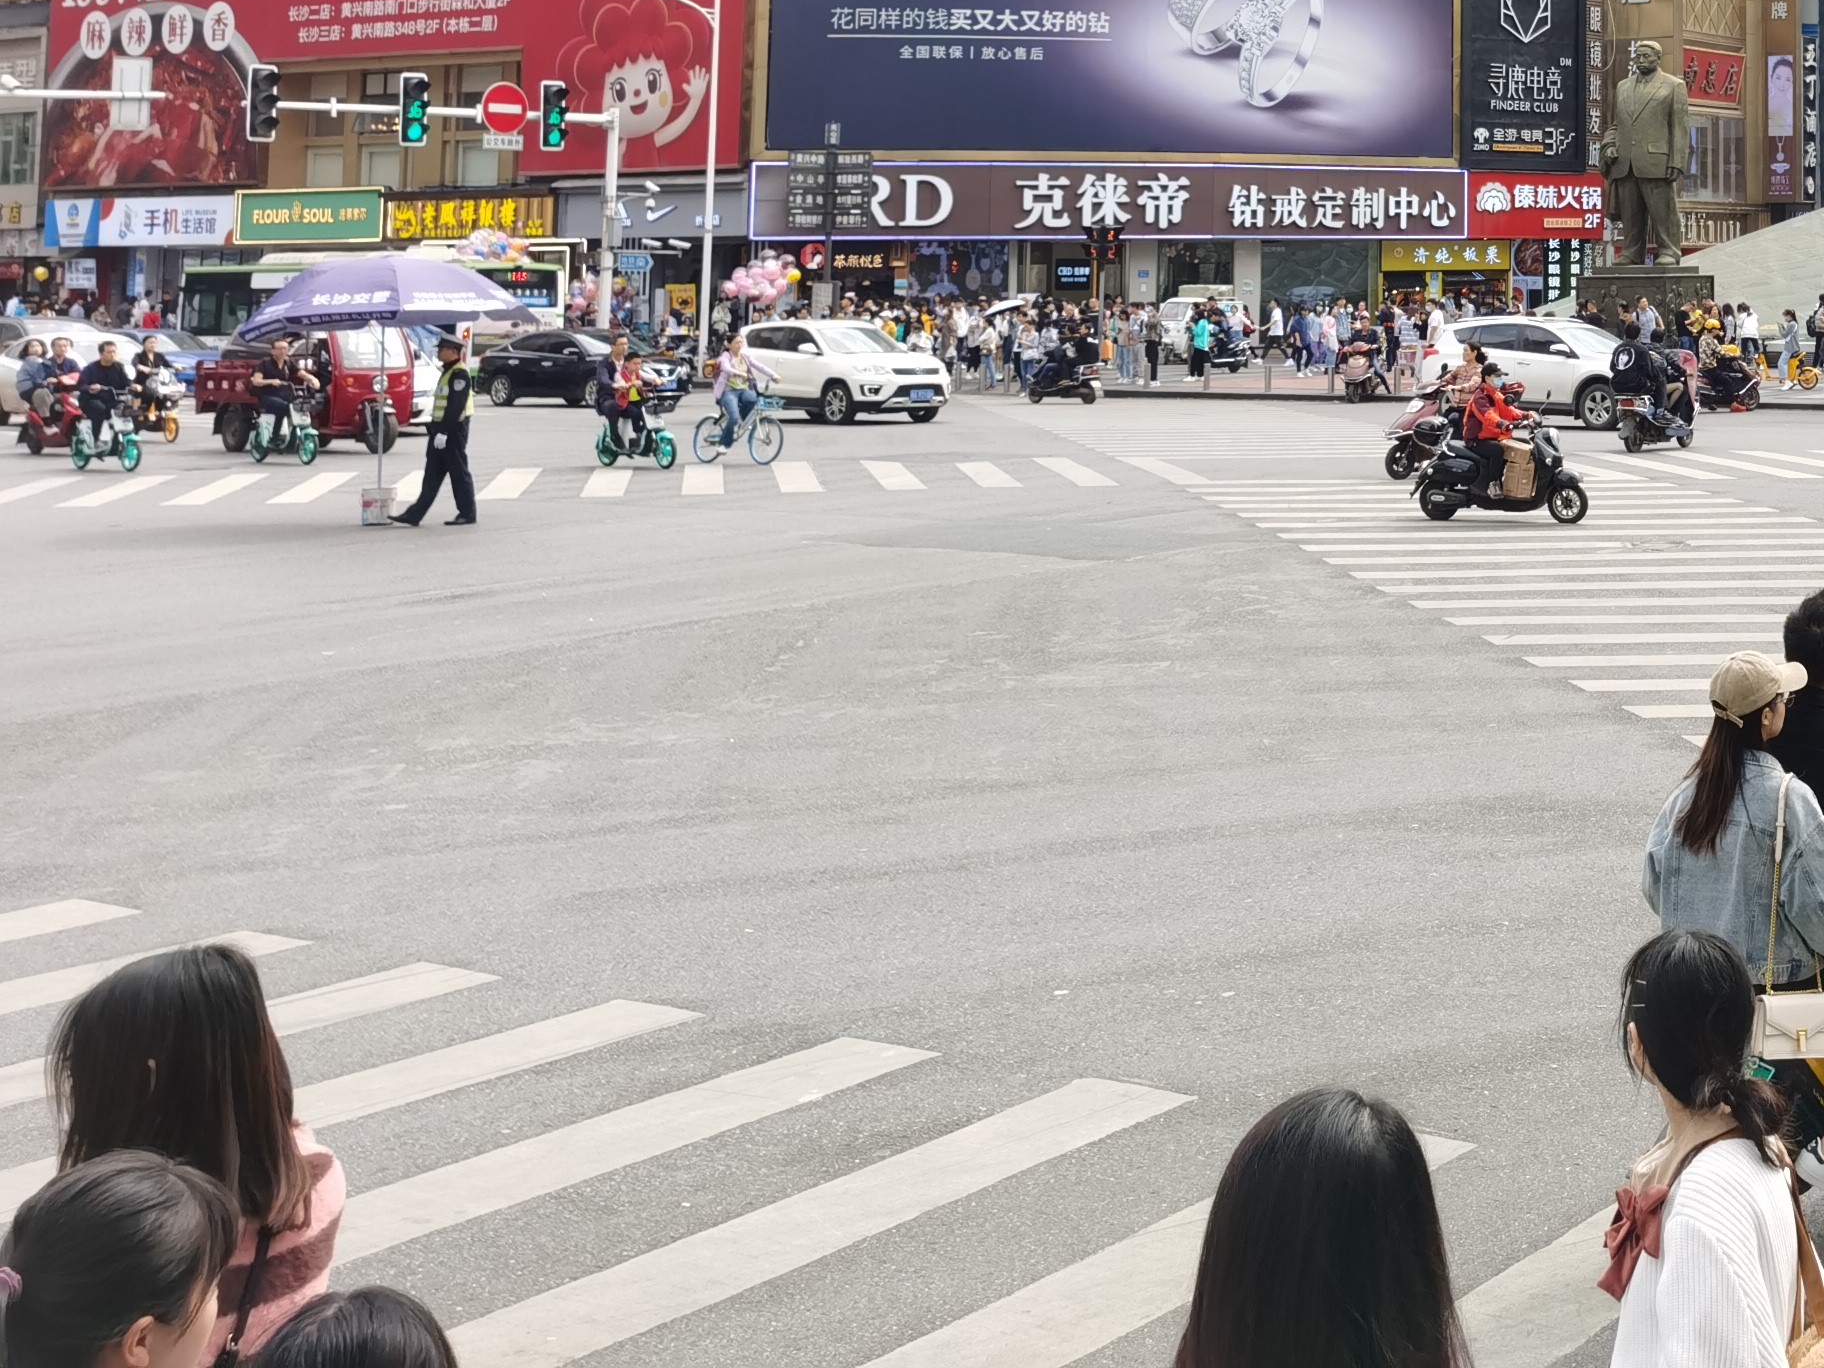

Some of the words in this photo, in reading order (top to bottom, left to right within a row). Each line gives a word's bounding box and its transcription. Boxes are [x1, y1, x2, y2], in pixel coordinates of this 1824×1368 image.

[829, 6, 1111, 34] 花同样的钱买又大又好的钻
[899, 45, 964, 60] 全国联保
[980, 46, 1044, 61] 放心售后
[1560, 58, 1572, 67] DM
[1488, 63, 1563, 100] 寻鹿电竞
[1490, 99, 1531, 112] FINDEER
[1533, 101, 1559, 113] CLUB
[1014, 172, 1193, 231] 克徕帝
[1227, 180, 1457, 230] 钻戒定制中心
[143, 208, 181, 236] 手机
[253, 208, 290, 225] FLOUR
[303, 207, 334, 224] SOUL
[1584, 214, 1602, 229] 2F
[181, 217, 217, 235] 生活馆
[1413, 245, 1502, 265] 清纯板栗
[312, 290, 391, 306] 长沙交警
